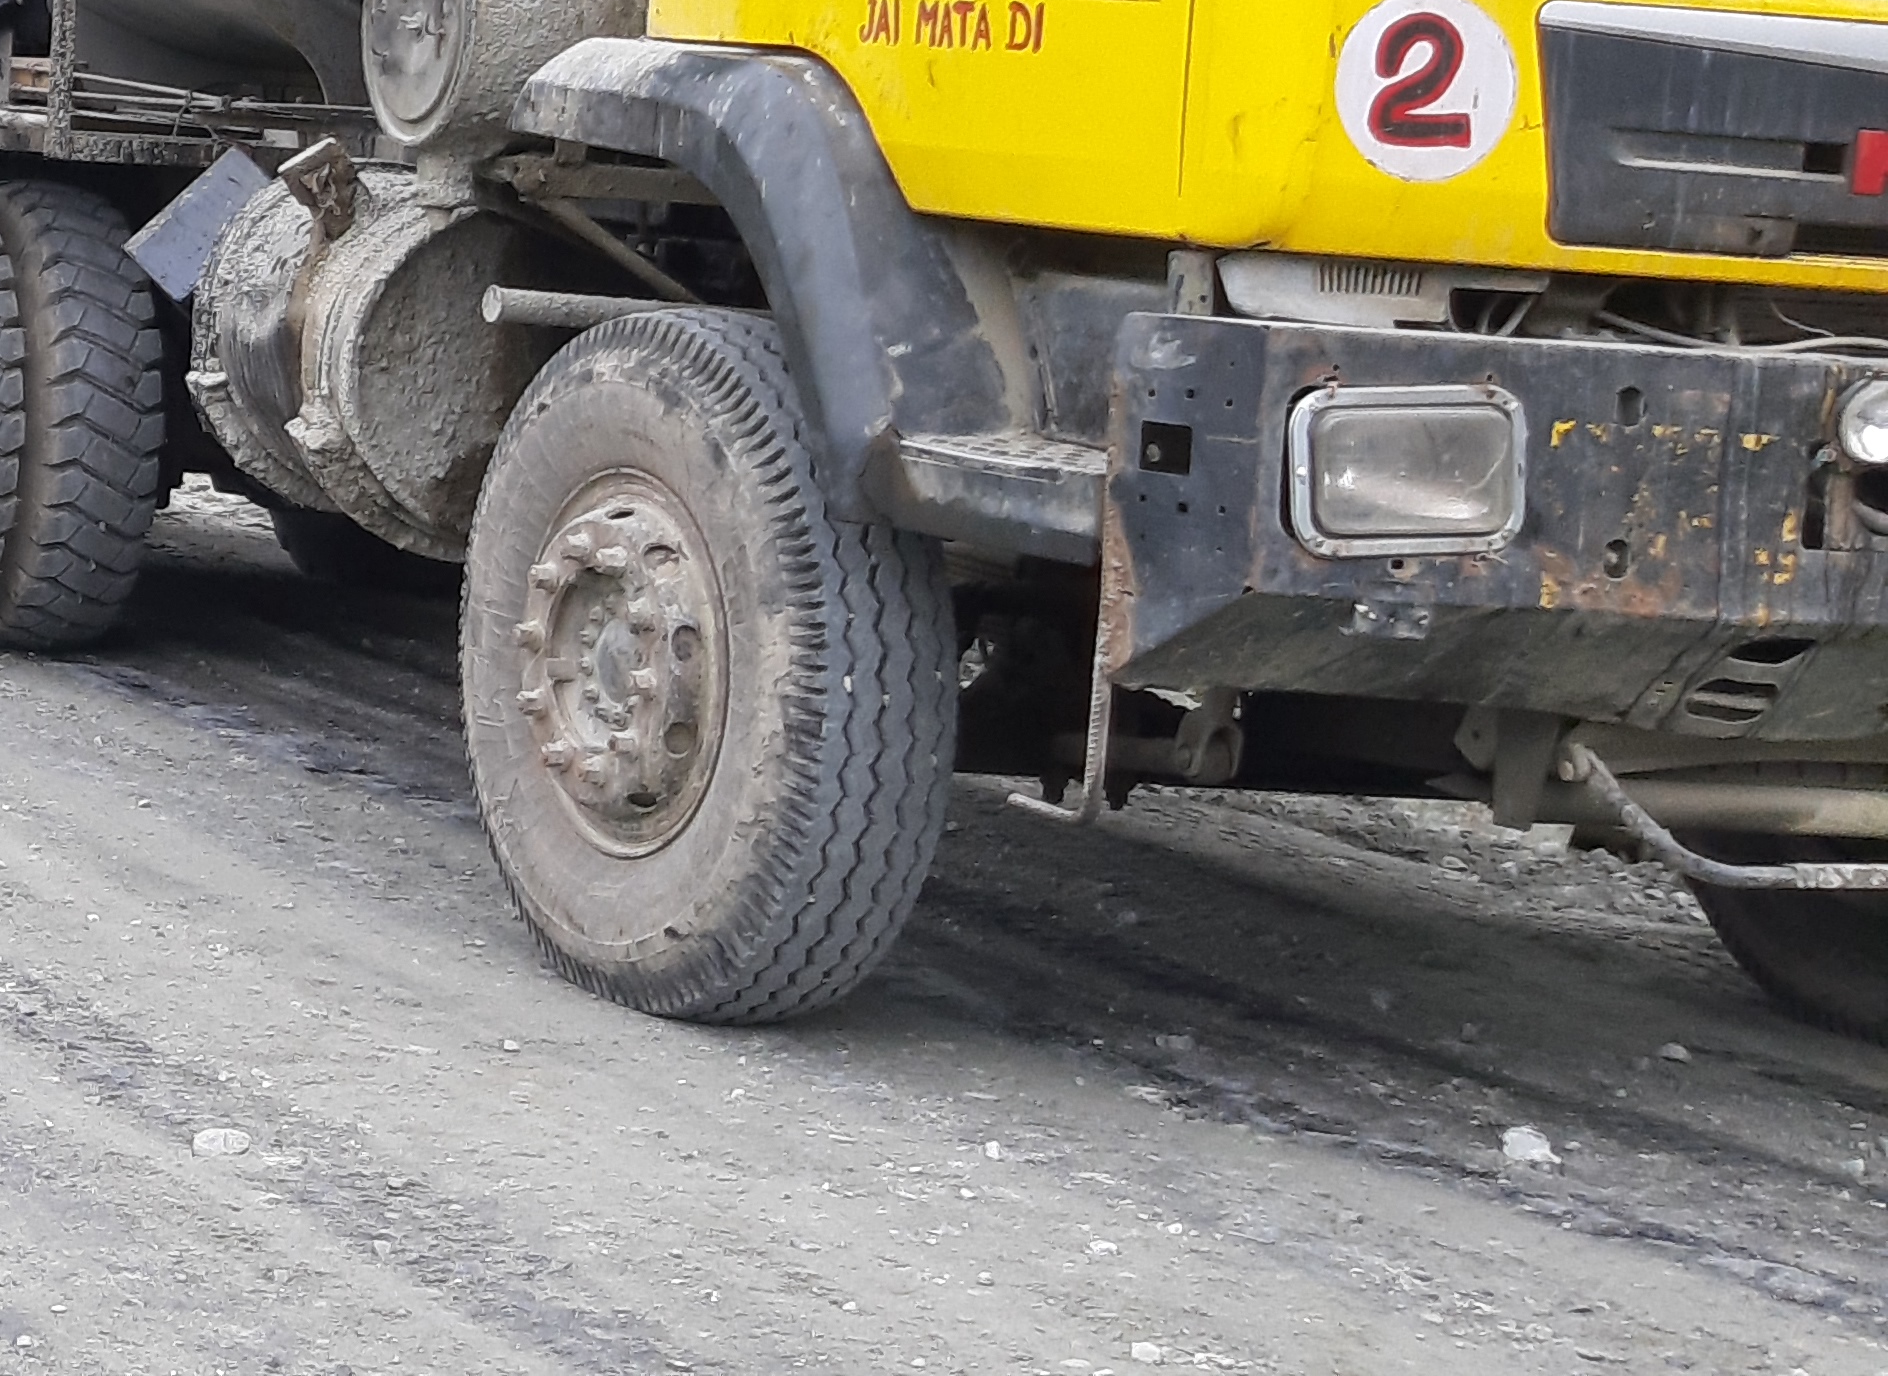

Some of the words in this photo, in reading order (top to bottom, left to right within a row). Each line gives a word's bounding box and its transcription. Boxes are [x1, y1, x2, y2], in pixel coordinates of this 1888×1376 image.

[915, 0, 991, 51] MATA
[1006, 1, 1045, 54] DI
[1367, 12, 1471, 148] 2
